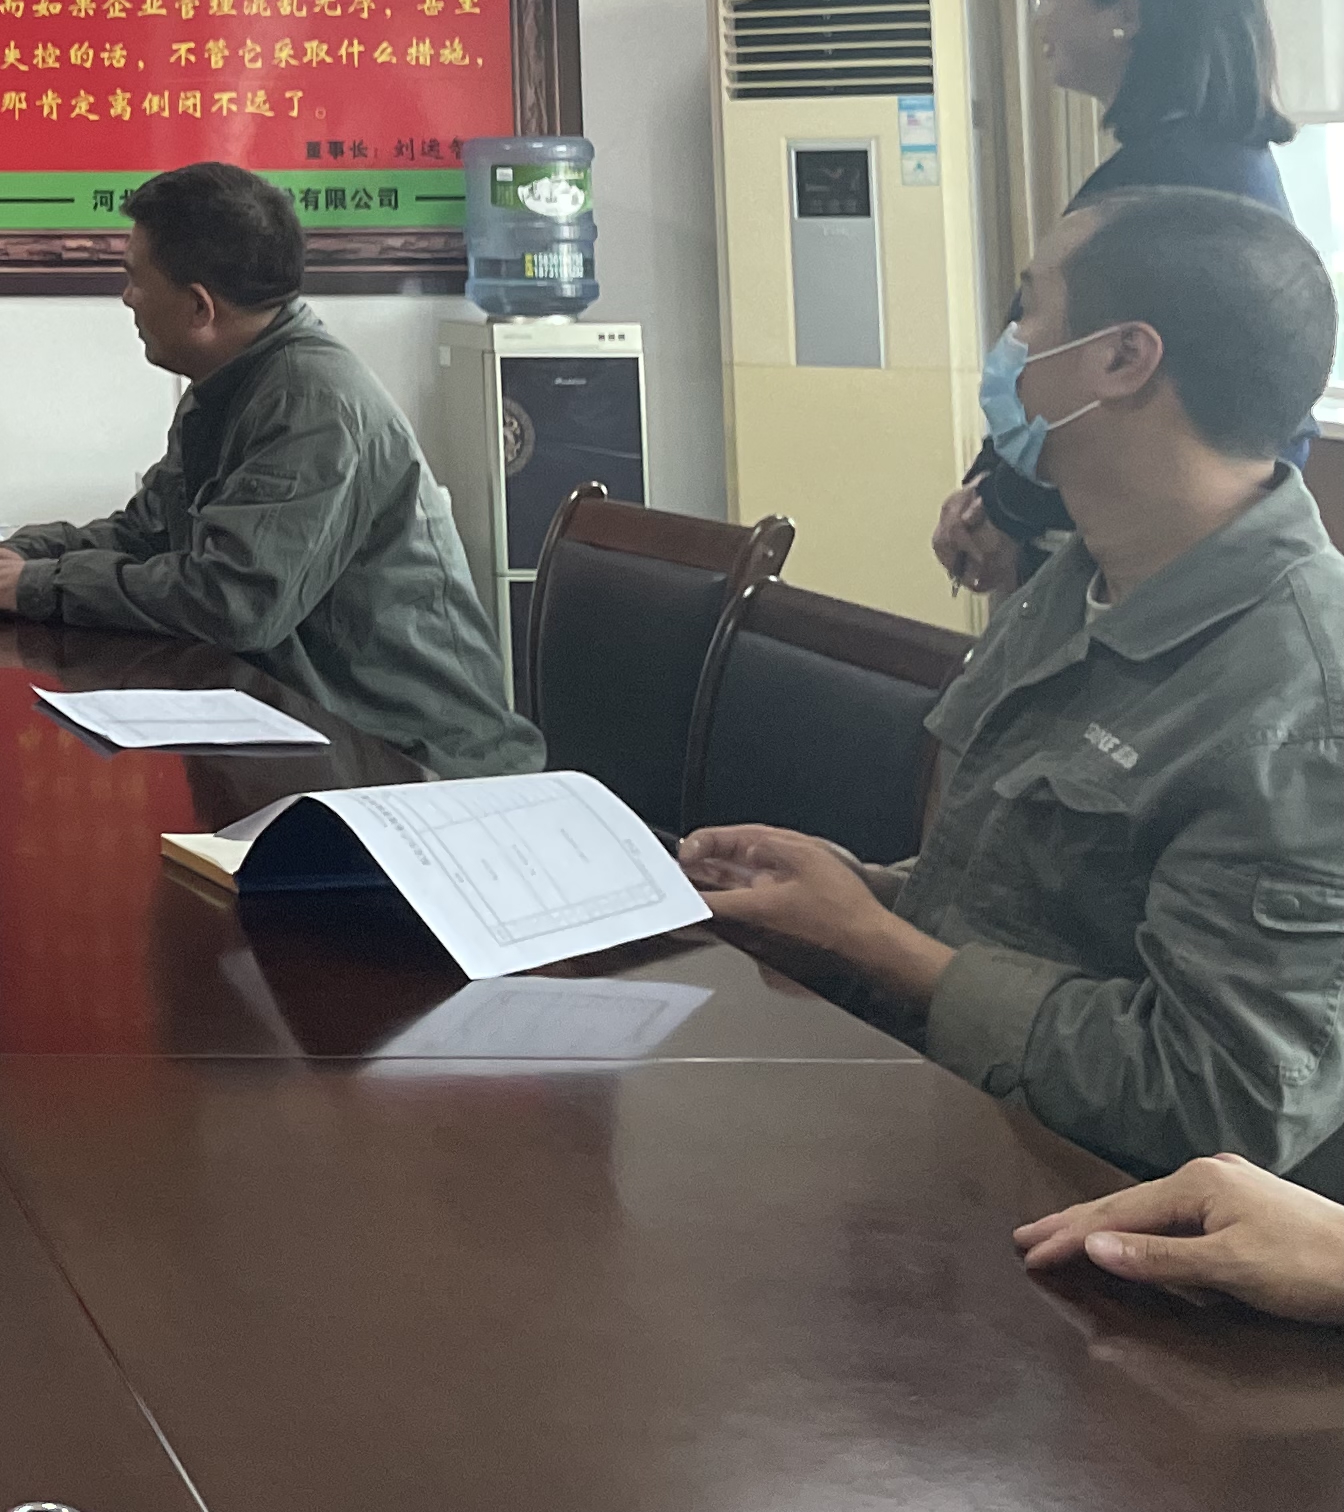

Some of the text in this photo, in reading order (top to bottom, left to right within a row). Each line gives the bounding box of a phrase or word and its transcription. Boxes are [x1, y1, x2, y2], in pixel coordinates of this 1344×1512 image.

[0, 38, 486, 72] 失控的话，不管它采取什么措施，
[1, 89, 327, 121] 那肯定离倒闭不远了。
